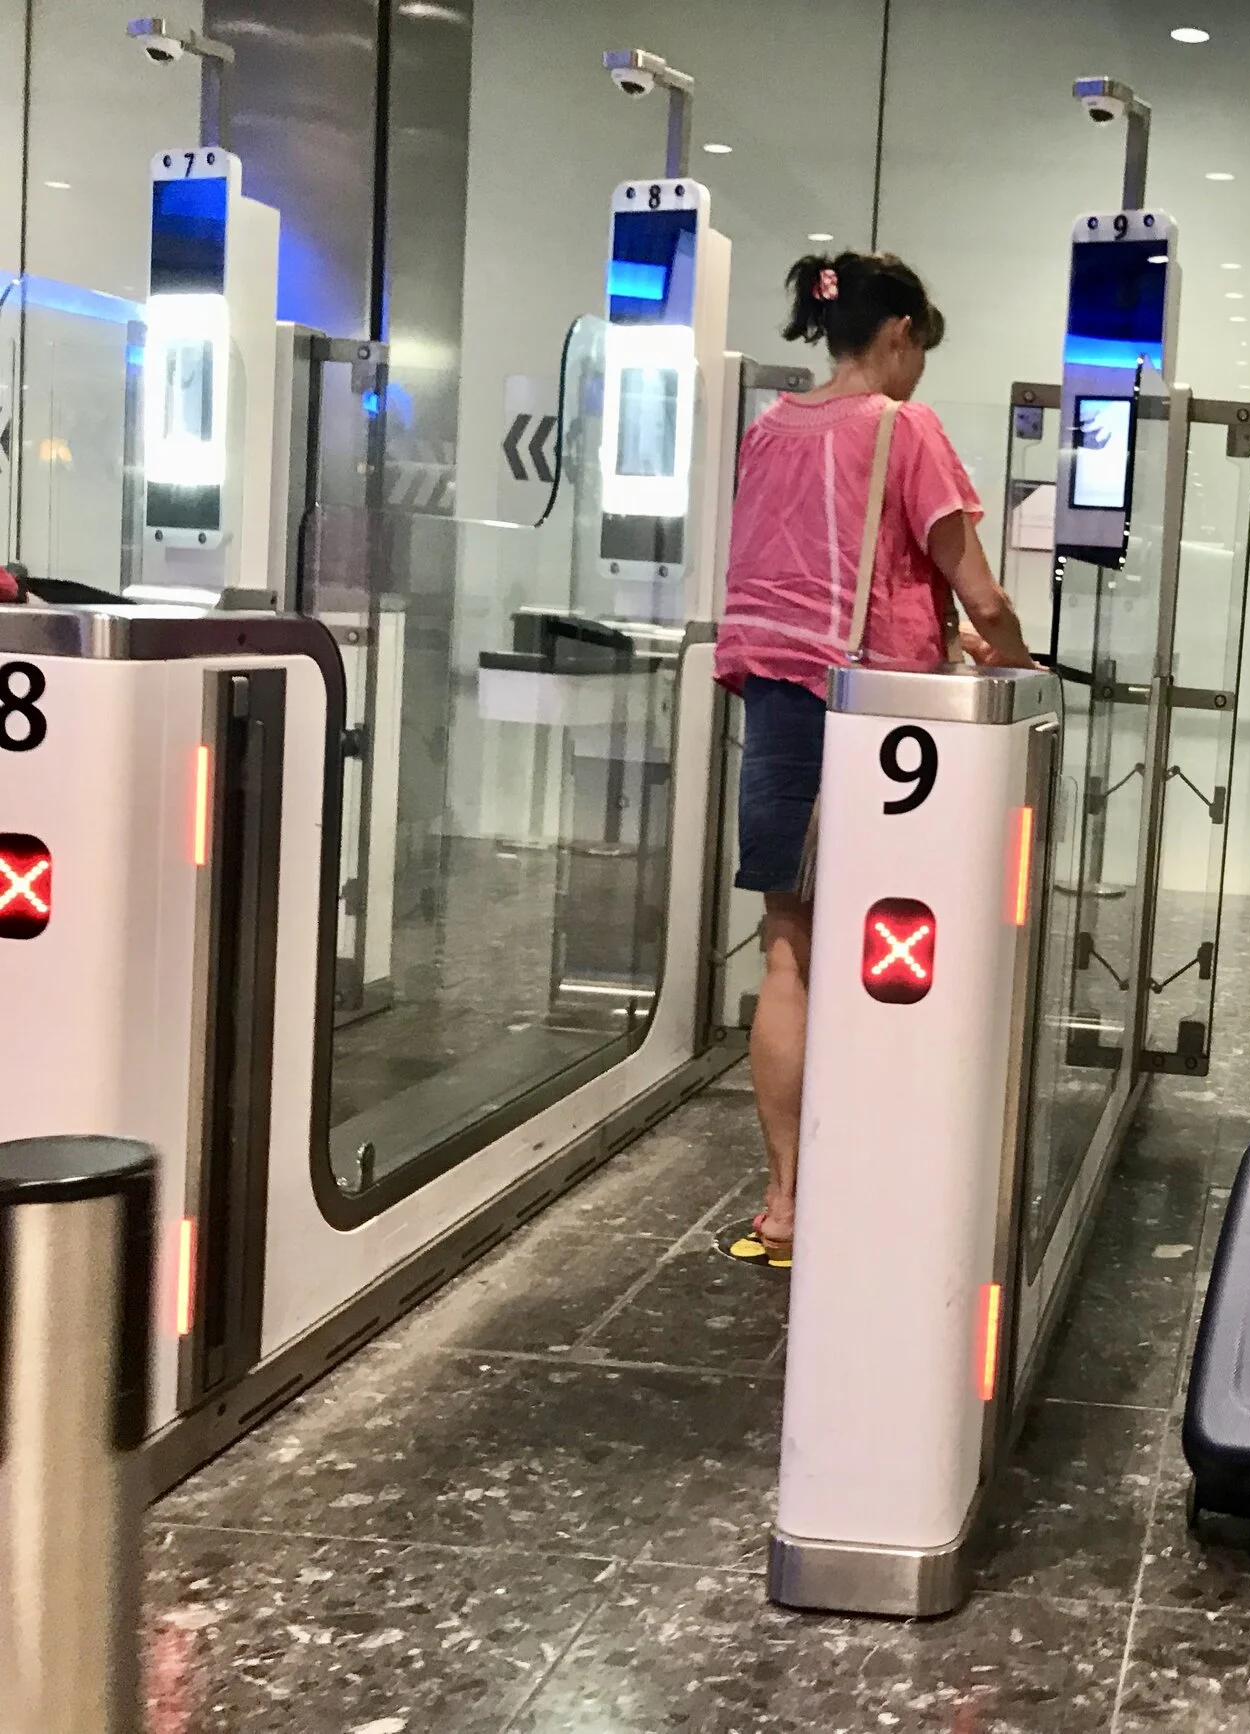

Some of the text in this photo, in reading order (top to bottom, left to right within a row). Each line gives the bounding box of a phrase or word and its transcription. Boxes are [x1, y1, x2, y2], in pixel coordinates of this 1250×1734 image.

[184, 152, 195, 178] 7
[649, 184, 661, 209] 8
[1113, 214, 1128, 240] 9
[0, 661, 47, 753] 8
[879, 724, 939, 815] 9
